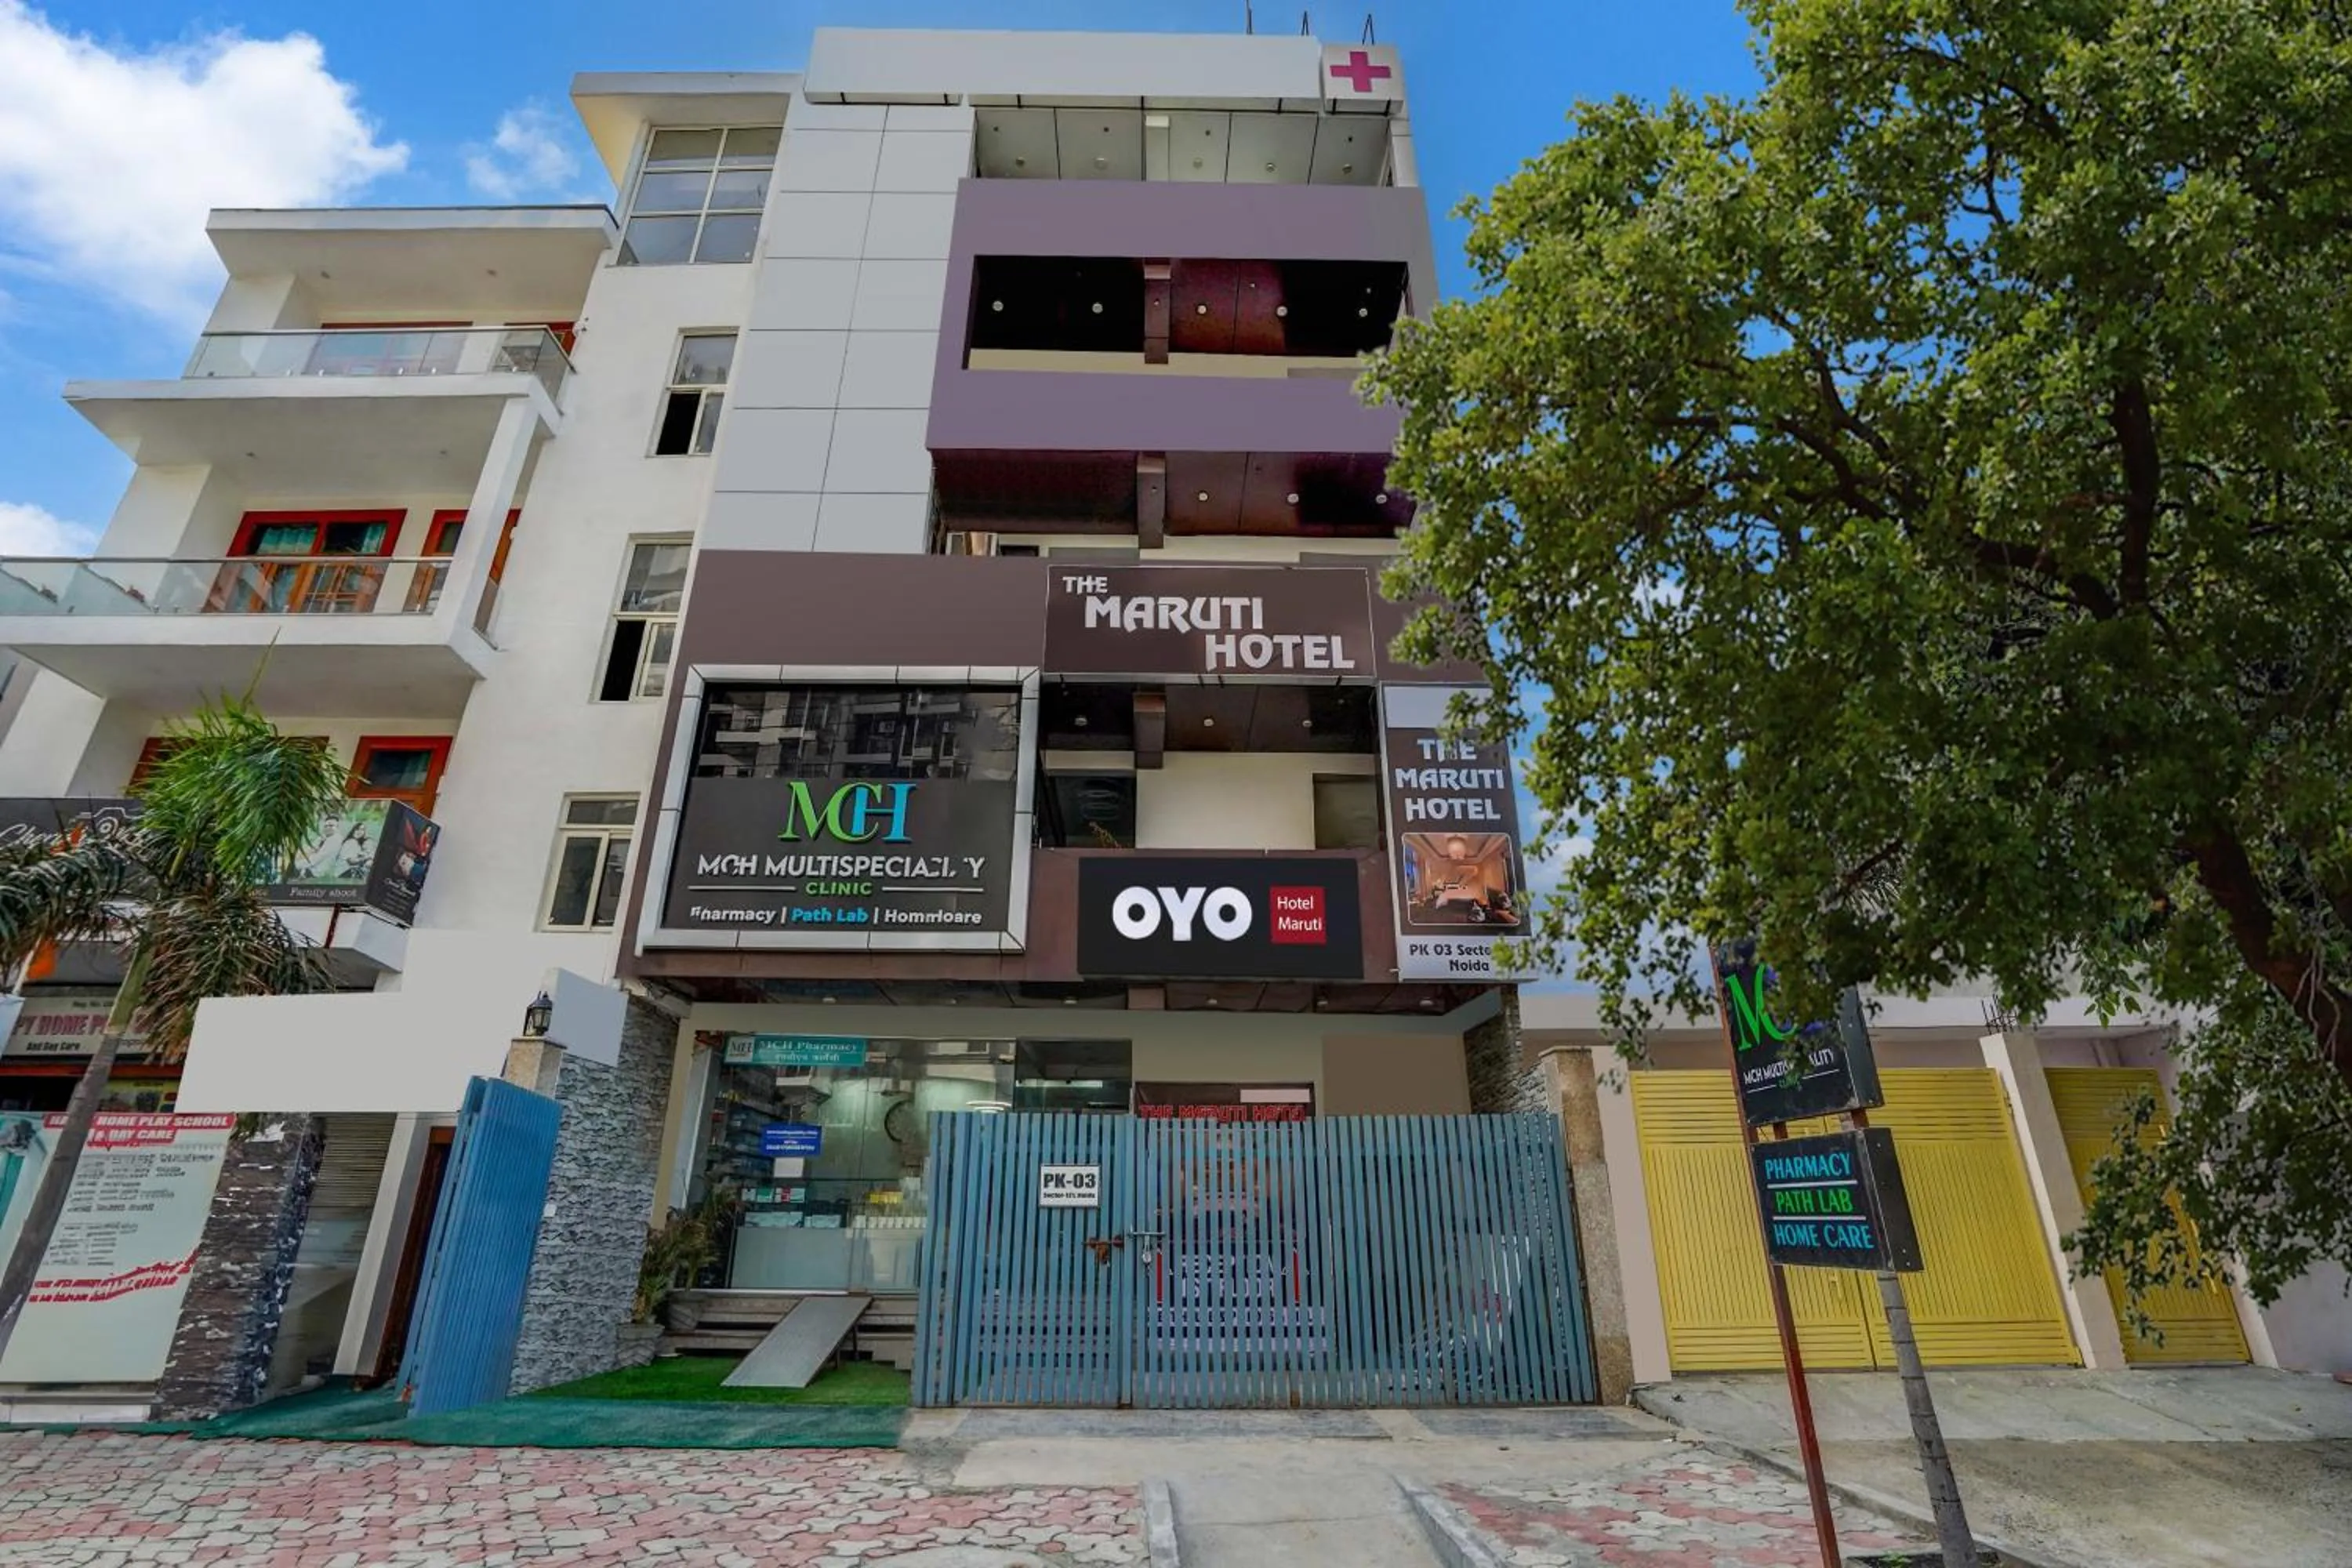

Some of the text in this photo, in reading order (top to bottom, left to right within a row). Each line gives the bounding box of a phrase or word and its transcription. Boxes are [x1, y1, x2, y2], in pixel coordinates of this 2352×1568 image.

[1062, 575, 1108, 595] THE
[1084, 596, 1263, 633] MARUTI
[1205, 634, 1355, 671] HOTEL
[1417, 739, 1477, 762] THE
[1395, 768, 1504, 790] MARUTI
[778, 781, 916, 844] MCH
[1405, 797, 1501, 822] HOTEL
[805, 882, 873, 895] CLINIC
[1277, 895, 1314, 910] Hotel
[791, 906, 832, 922] Path
[837, 907, 869, 922] Lab
[1112, 886, 1253, 941] OYO
[1278, 916, 1323, 931] Maruti
[1410, 943, 1494, 956] PK 03 Secto
[1450, 959, 1490, 971] Noida
[98, 1116, 136, 1126] HOME
[139, 1116, 172, 1127] PLAY
[174, 1116, 228, 1127] SCHOOL
[137, 1129, 174, 1139] CARE
[1765, 1152, 1852, 1180] PHARMACY
[1044, 1172, 1096, 1189] PK-03
[1775, 1188, 1853, 1214] PATH LAB
[1774, 1225, 1875, 1249] HOME CARE
